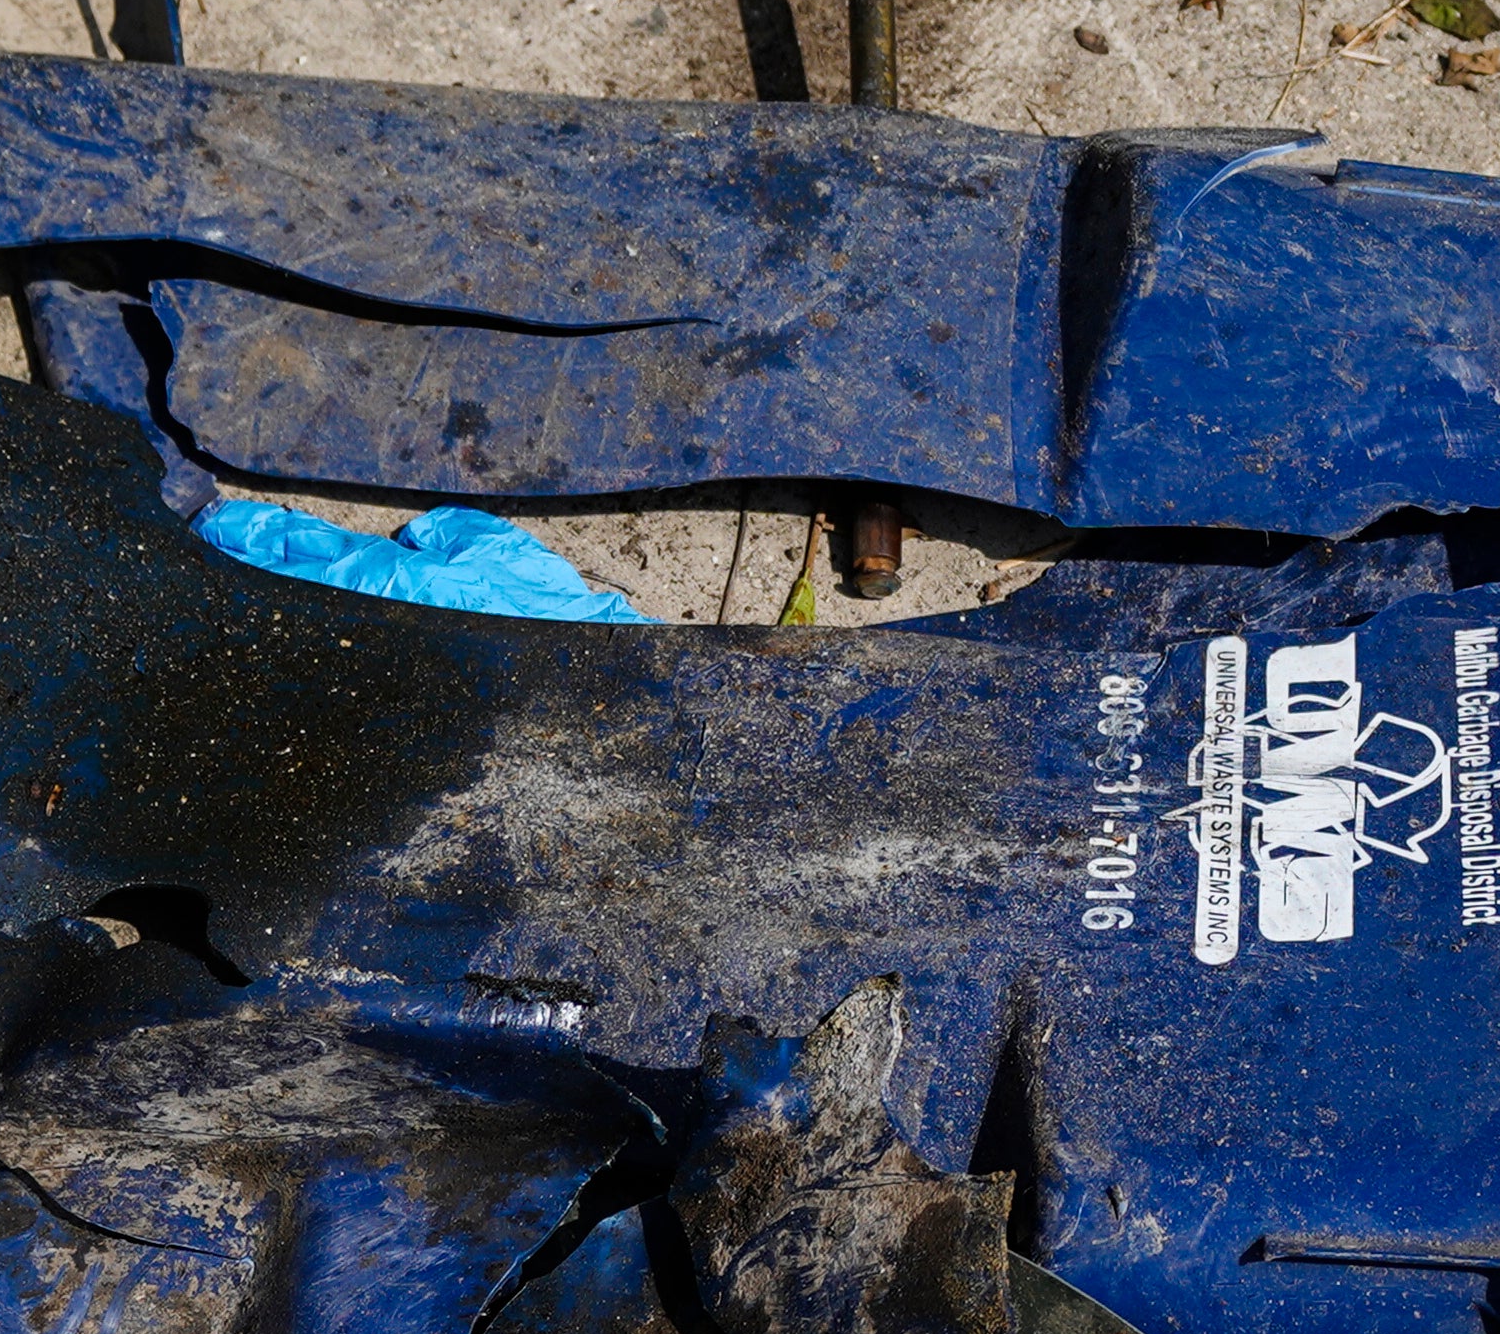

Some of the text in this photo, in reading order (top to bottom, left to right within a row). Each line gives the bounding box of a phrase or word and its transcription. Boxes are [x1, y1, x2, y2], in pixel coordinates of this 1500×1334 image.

[1454, 627, 1499, 688] Malibu
[1214, 651, 1236, 746] UNIVERSAL
[1448, 691, 1500, 767] Garbage
[1211, 751, 1234, 815] WASTE
[1258, 632, 1361, 942] UWS
[1208, 820, 1232, 906] SYSTEMS
